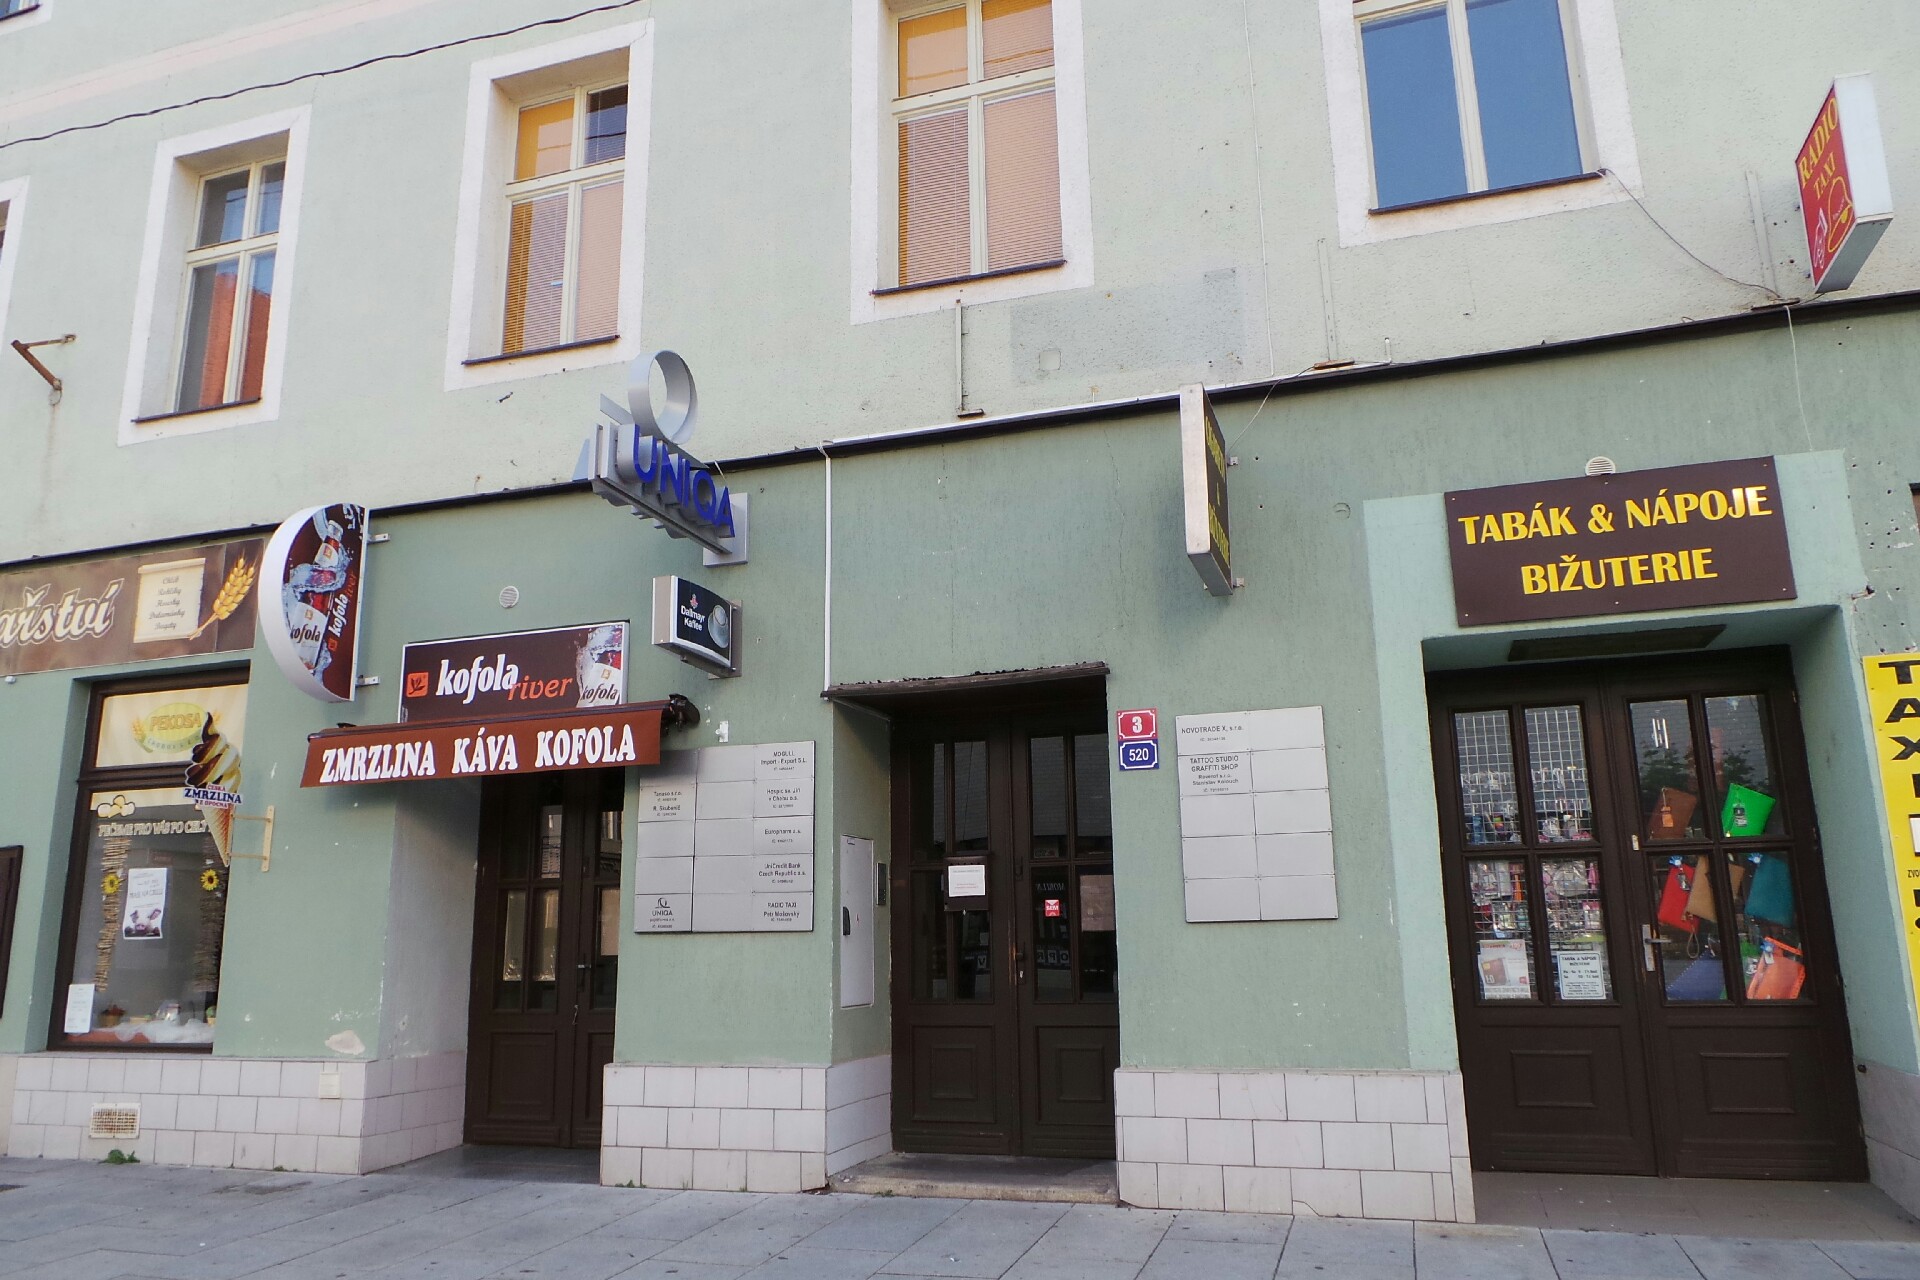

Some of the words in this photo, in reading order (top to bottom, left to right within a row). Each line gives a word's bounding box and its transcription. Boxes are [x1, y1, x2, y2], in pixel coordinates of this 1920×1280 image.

[1798, 97, 1839, 189] RADIO
[1813, 152, 1836, 200] TAXI
[633, 423, 735, 538] UNIQA
[1458, 502, 1578, 545] TABÁK
[1587, 504, 1615, 534] &
[1625, 485, 1773, 529] NÁPOJE
[1521, 548, 1718, 595] BIŽUTERIE
[328, 593, 348, 637] kofola
[680, 605, 705, 623] Dalmayr
[684, 617, 703, 631] Kaffee
[435, 654, 519, 705] kofola
[508, 675, 574, 701] river
[150, 712, 201, 731] PEKOSA
[1132, 716, 1143, 733] 3
[1181, 725, 1220, 734] NOVOTRADE
[319, 740, 436, 784] ZMRZLINA
[451, 727, 518, 773] KÁVA
[534, 723, 636, 768] KOFOLA
[1129, 748, 1149, 761] 520
[184, 787, 242, 804] ZMRZLINA
[652, 909, 673, 917] UNIQA
